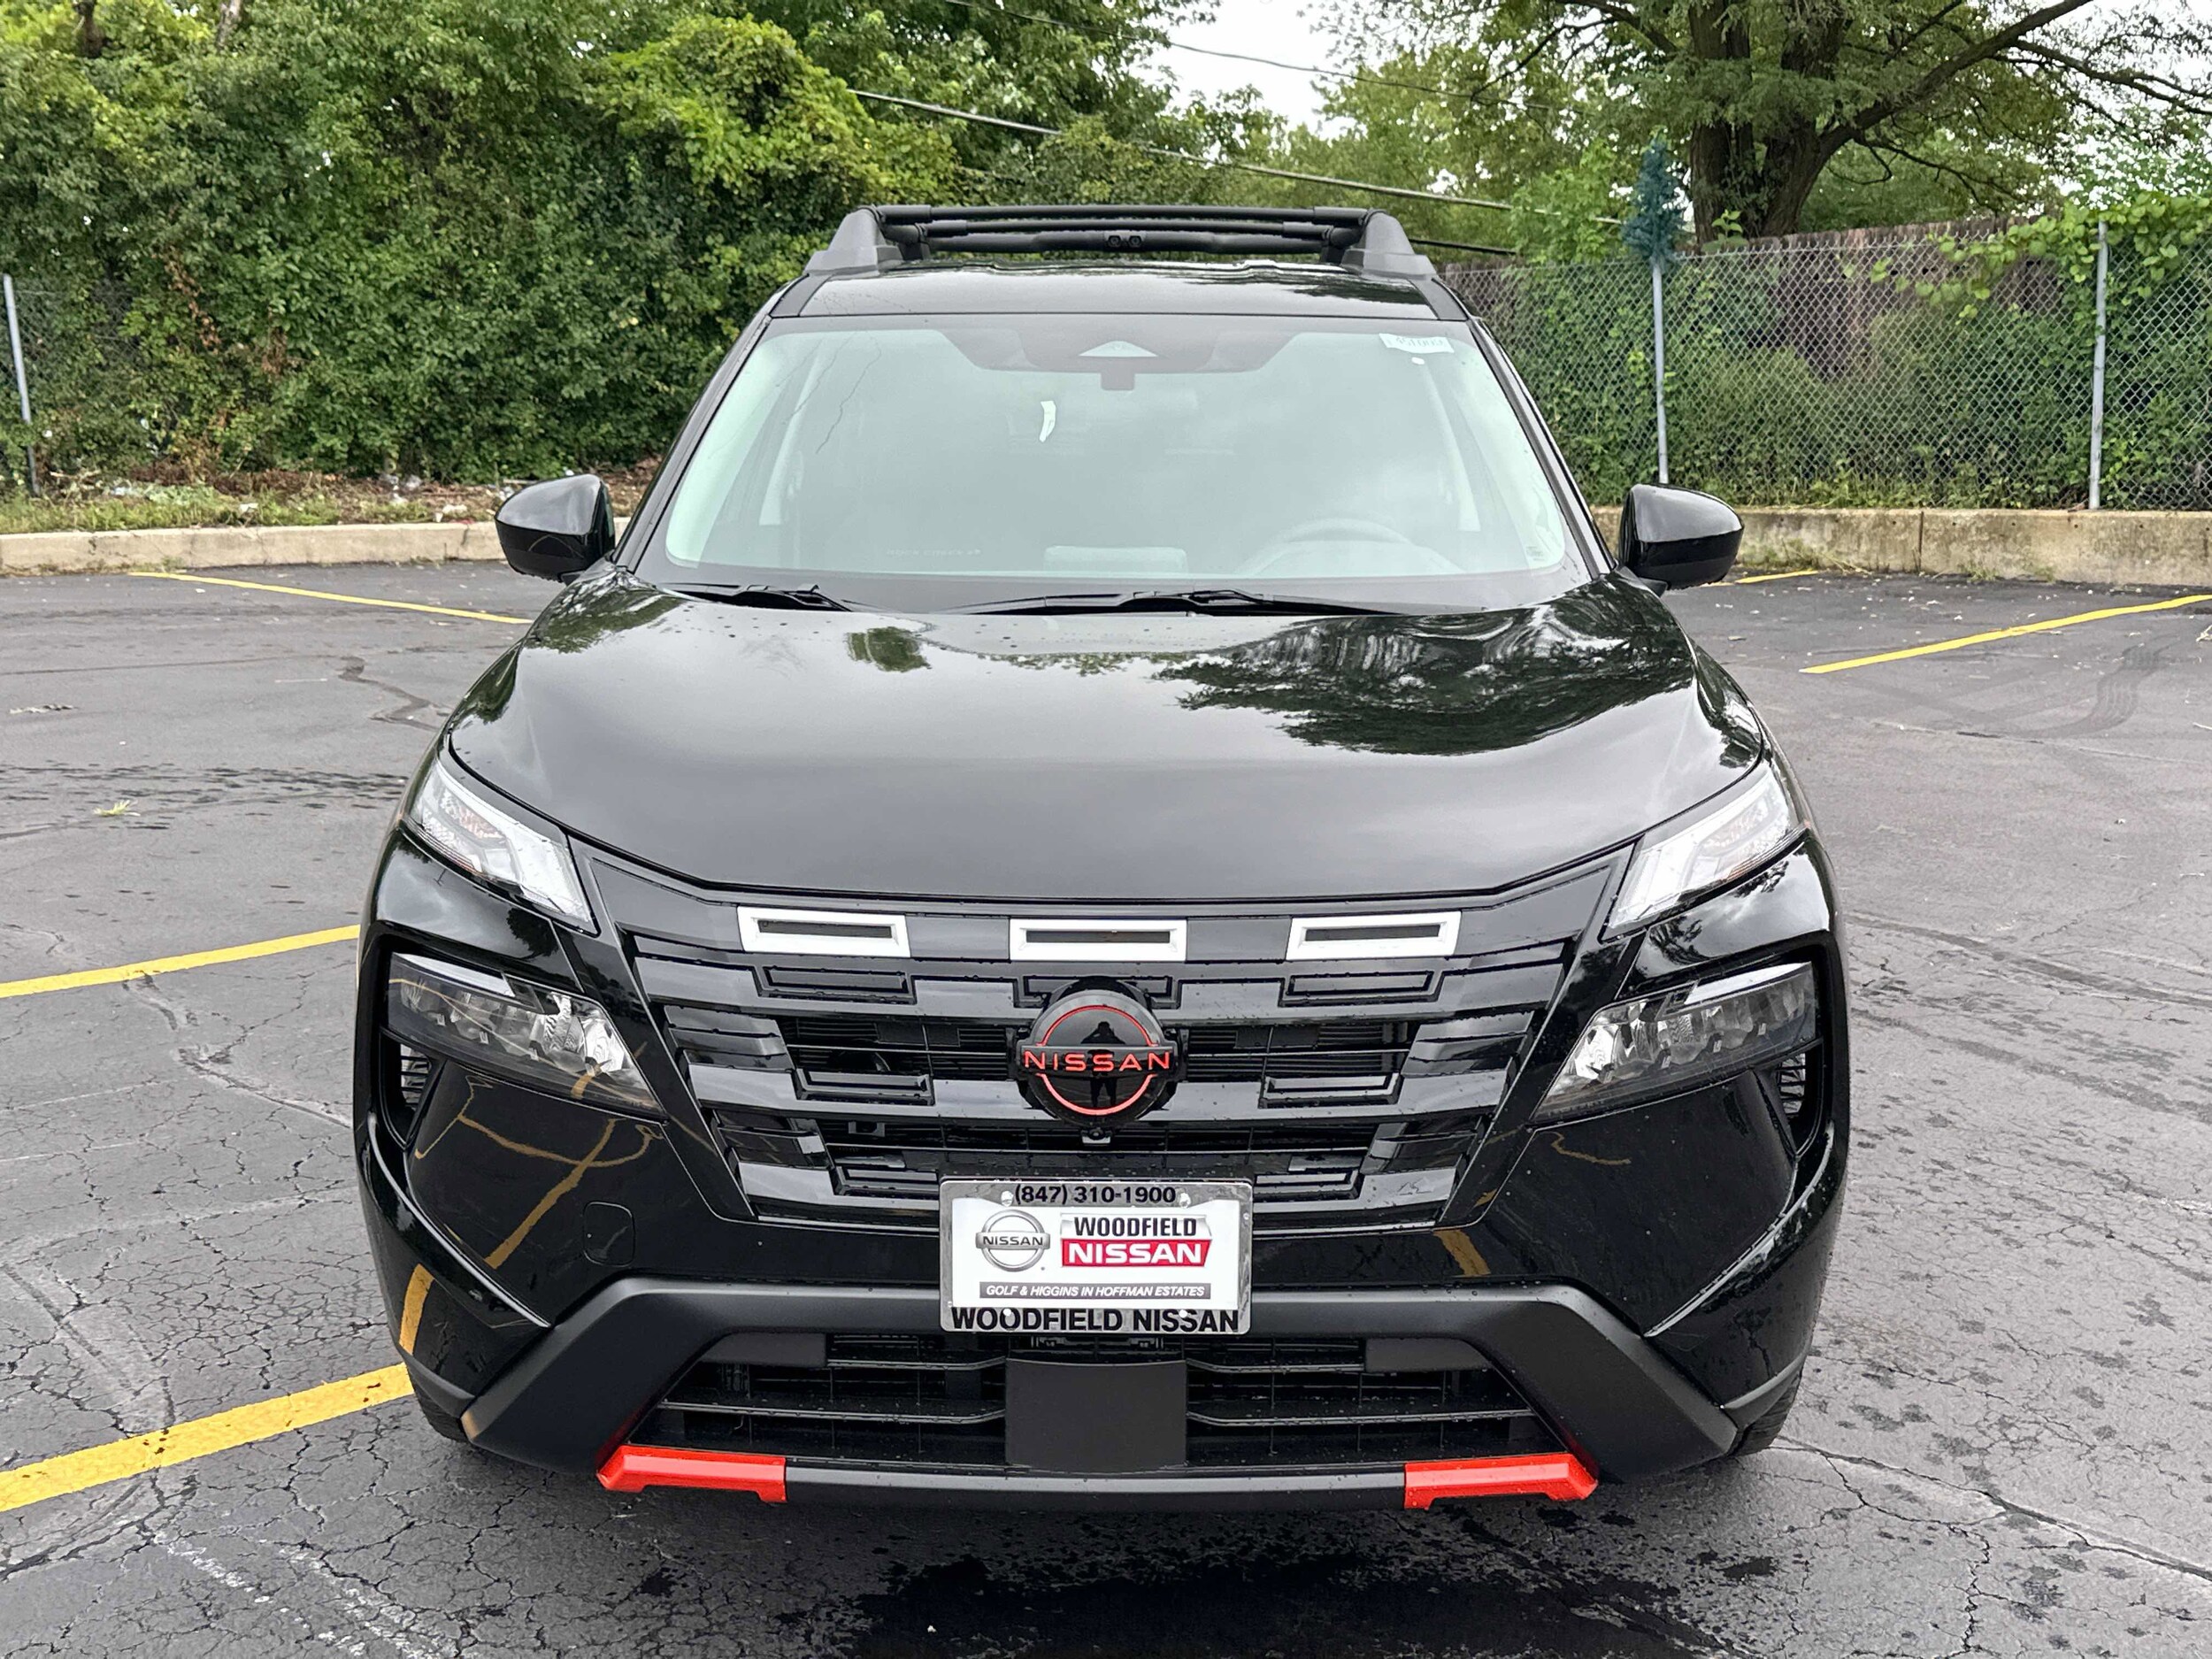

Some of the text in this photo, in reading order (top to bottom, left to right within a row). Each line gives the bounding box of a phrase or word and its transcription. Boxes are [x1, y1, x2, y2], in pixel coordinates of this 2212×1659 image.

[1023, 1049, 1170, 1072] NISSAN
[1014, 1185, 1177, 1205] (847) 310-1900
[1073, 1216, 1197, 1238] WOODFIELD
[982, 1234, 1044, 1247] NISSAN
[1067, 1242, 1202, 1264] NISSAN
[986, 1284, 1205, 1297] GOLF & HIGGINS IN HOFFMAN ESTATES
[951, 1306, 1239, 1333] WOODFIELD NISSAN
